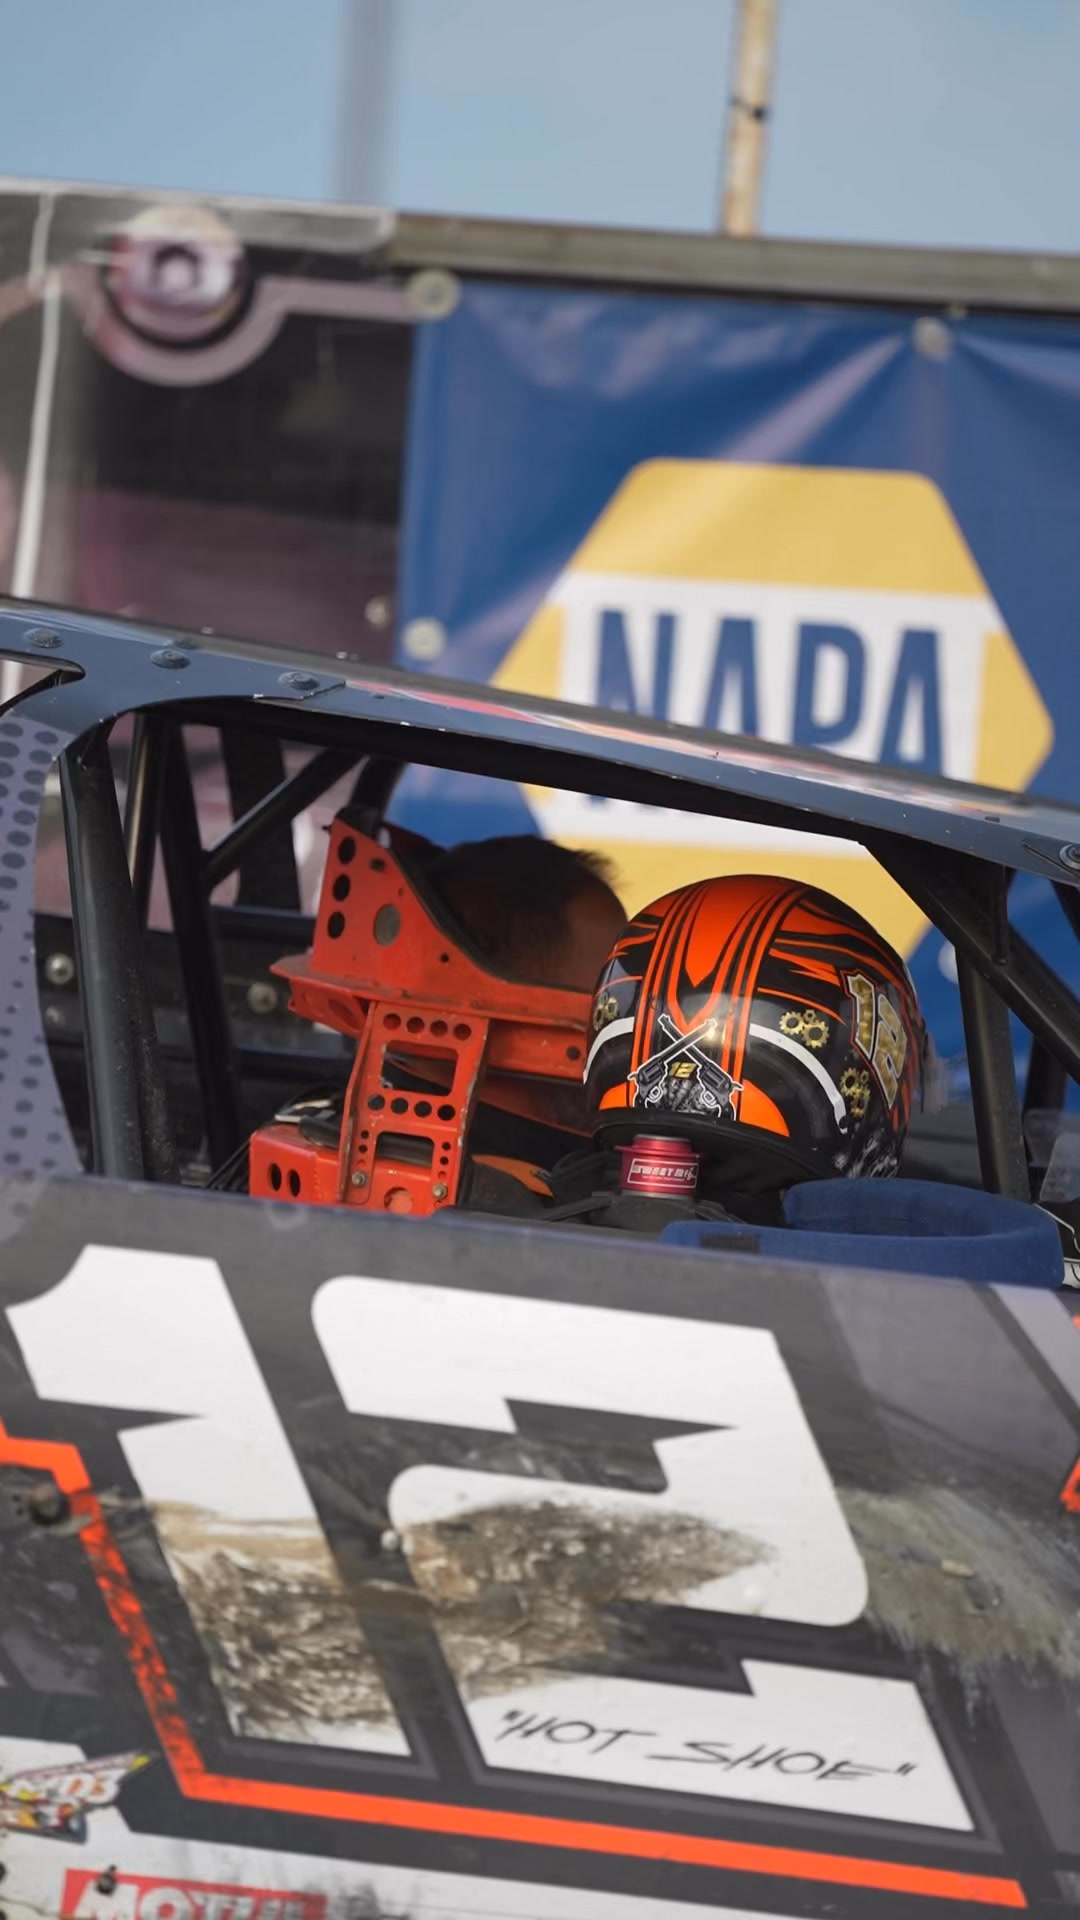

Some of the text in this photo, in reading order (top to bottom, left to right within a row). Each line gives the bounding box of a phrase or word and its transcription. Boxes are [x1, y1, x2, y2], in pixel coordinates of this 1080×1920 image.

[592, 608, 944, 778] NAPA
[669, 1061, 698, 1079] 12
[6, 1243, 975, 1832] 12
